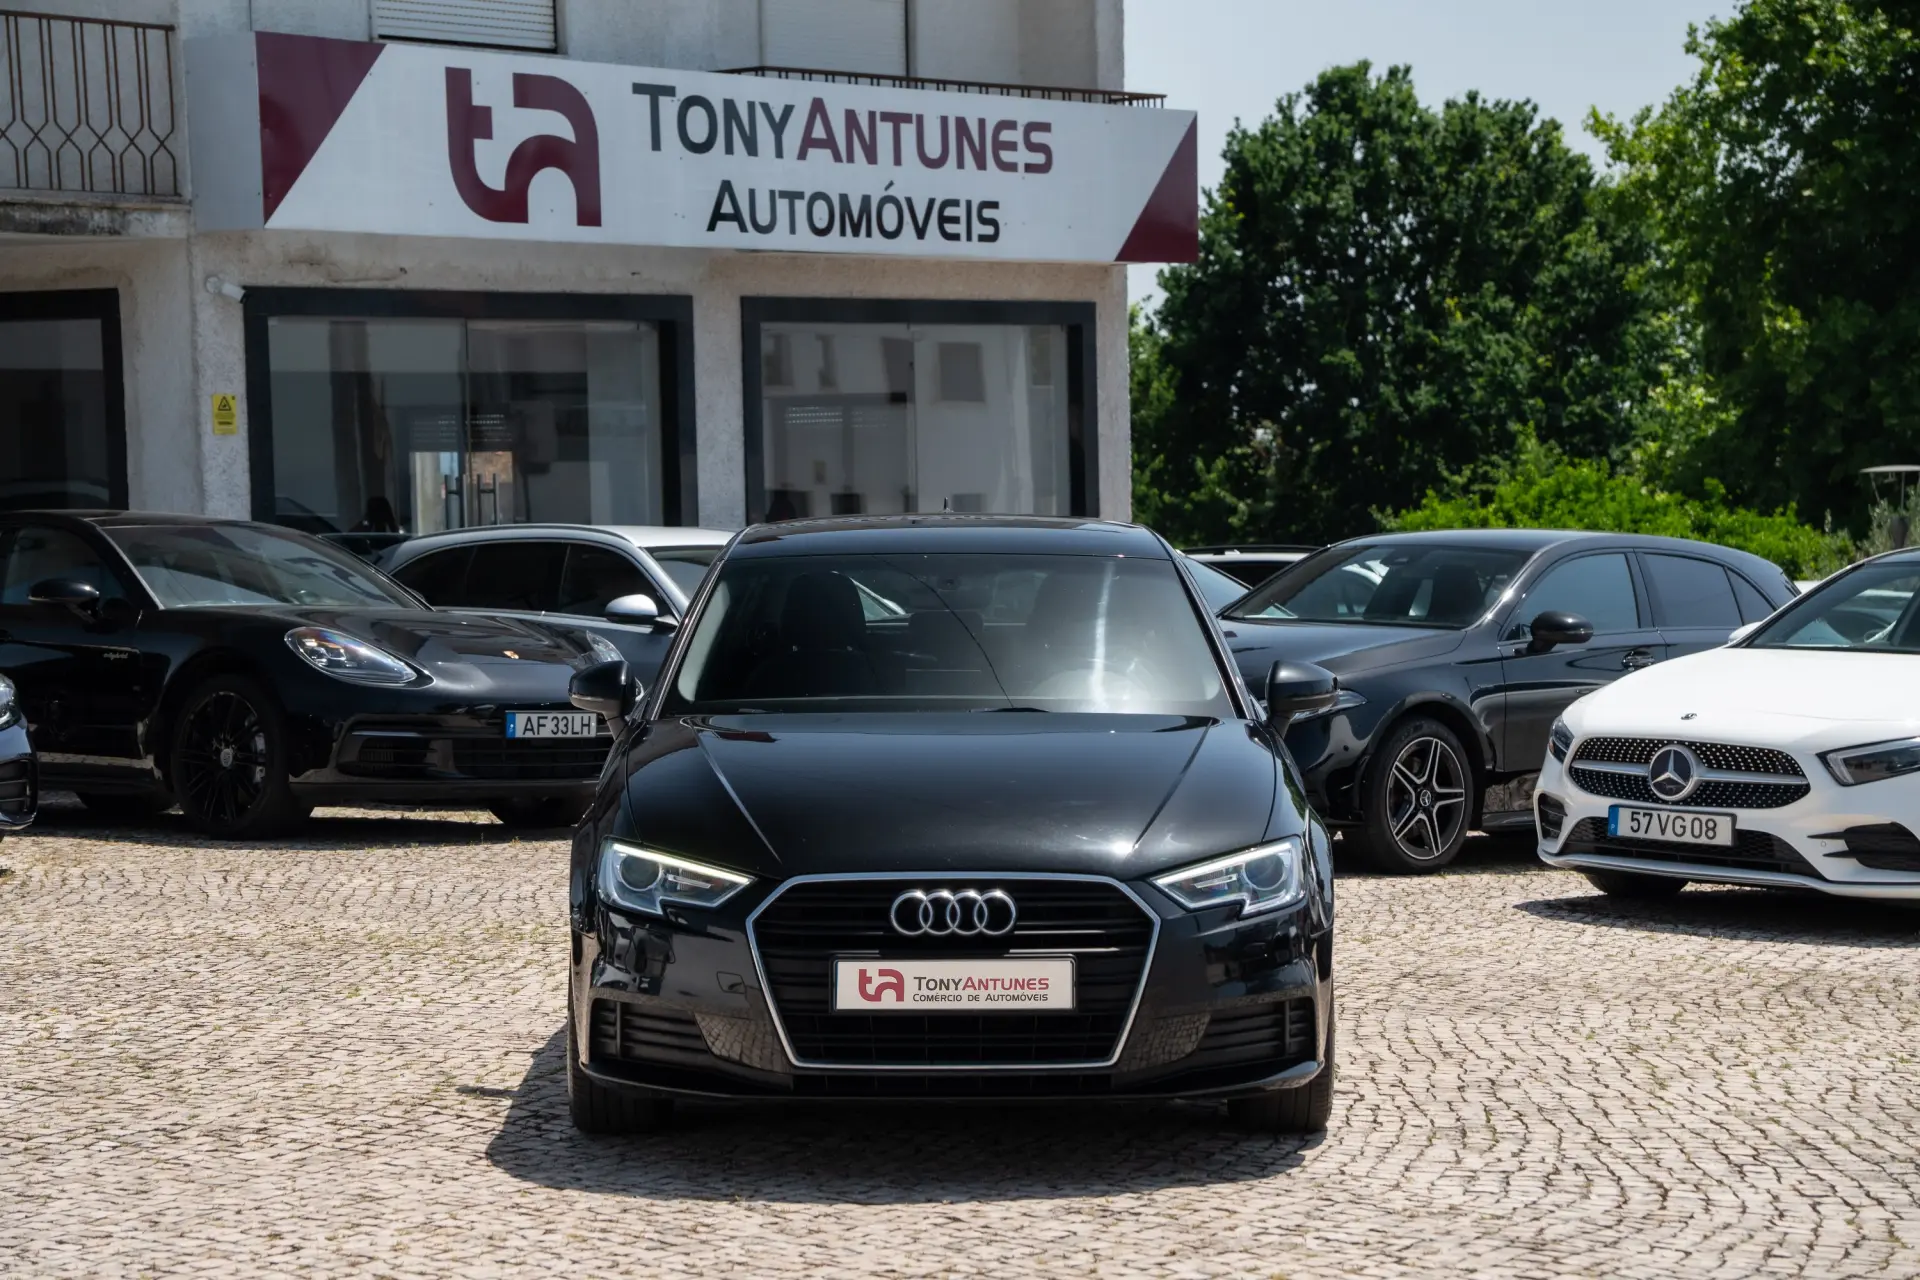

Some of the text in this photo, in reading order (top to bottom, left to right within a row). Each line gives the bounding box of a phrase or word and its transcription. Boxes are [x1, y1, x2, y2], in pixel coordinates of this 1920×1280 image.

[706, 180, 1000, 243] AUTOMÓVEIS
[912, 991, 1049, 1002] COMÉRCIO DE AUTOMÓVEIS
